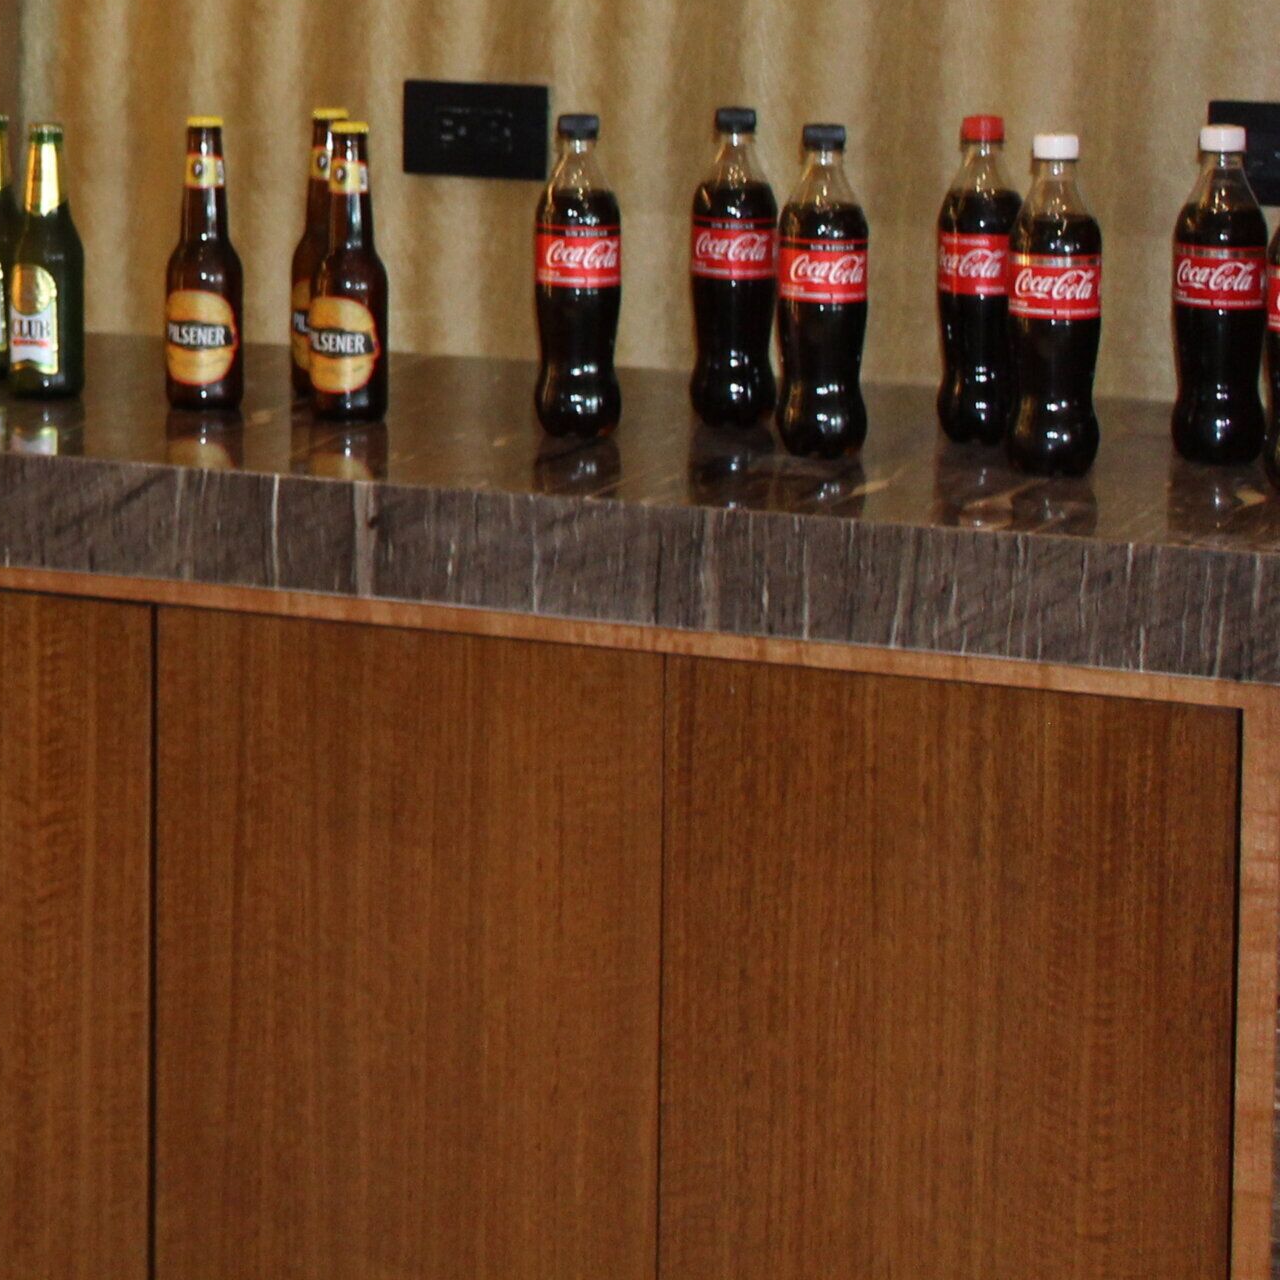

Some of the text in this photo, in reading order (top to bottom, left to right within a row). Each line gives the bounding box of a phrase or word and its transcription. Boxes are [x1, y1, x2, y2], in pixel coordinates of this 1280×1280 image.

[546, 239, 619, 269] Coca-Cola
[696, 232, 770, 262] Coca-Cola
[790, 254, 865, 285] Coca-Cola
[1015, 268, 1095, 300] Coca-Cola
[1177, 258, 1257, 291] Coca-Cola
